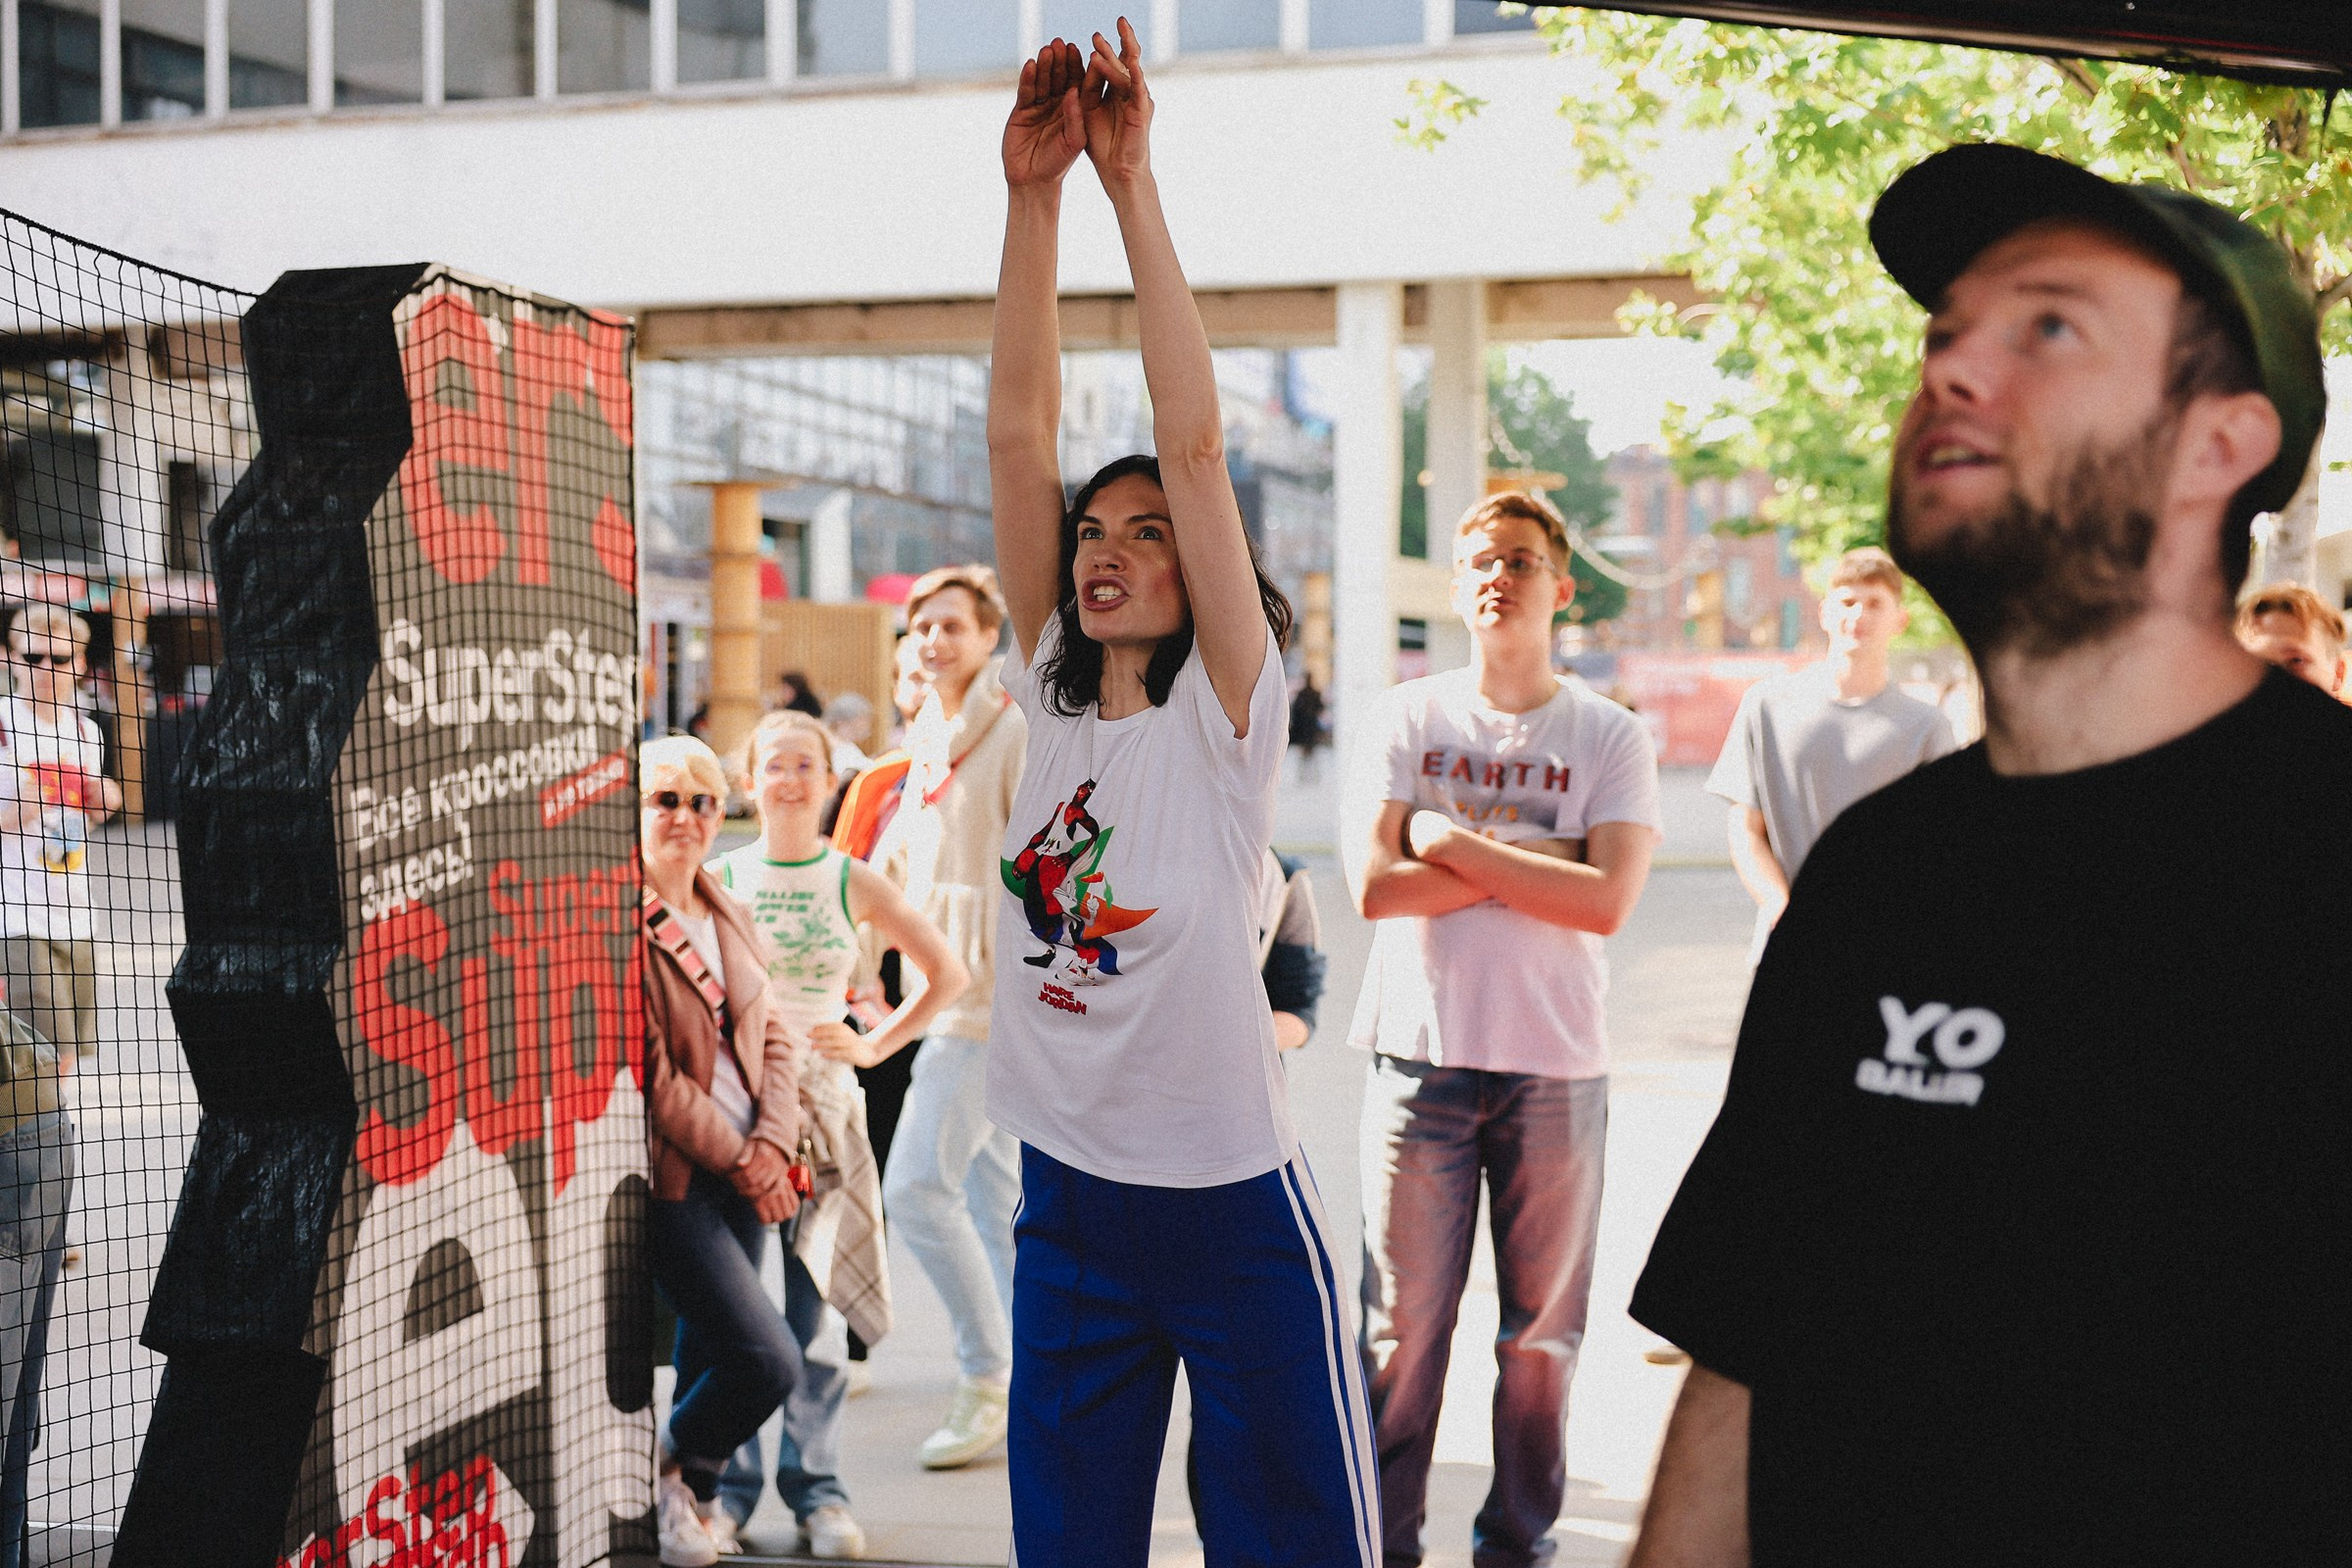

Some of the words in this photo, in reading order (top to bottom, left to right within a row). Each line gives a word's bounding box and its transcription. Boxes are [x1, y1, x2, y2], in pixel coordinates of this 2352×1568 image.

[1422, 751, 1571, 793] EARTH
[1037, 990, 1088, 1015] JORDAN
[1043, 981, 1075, 1002] HARE
[1878, 995, 2006, 1070] YO
